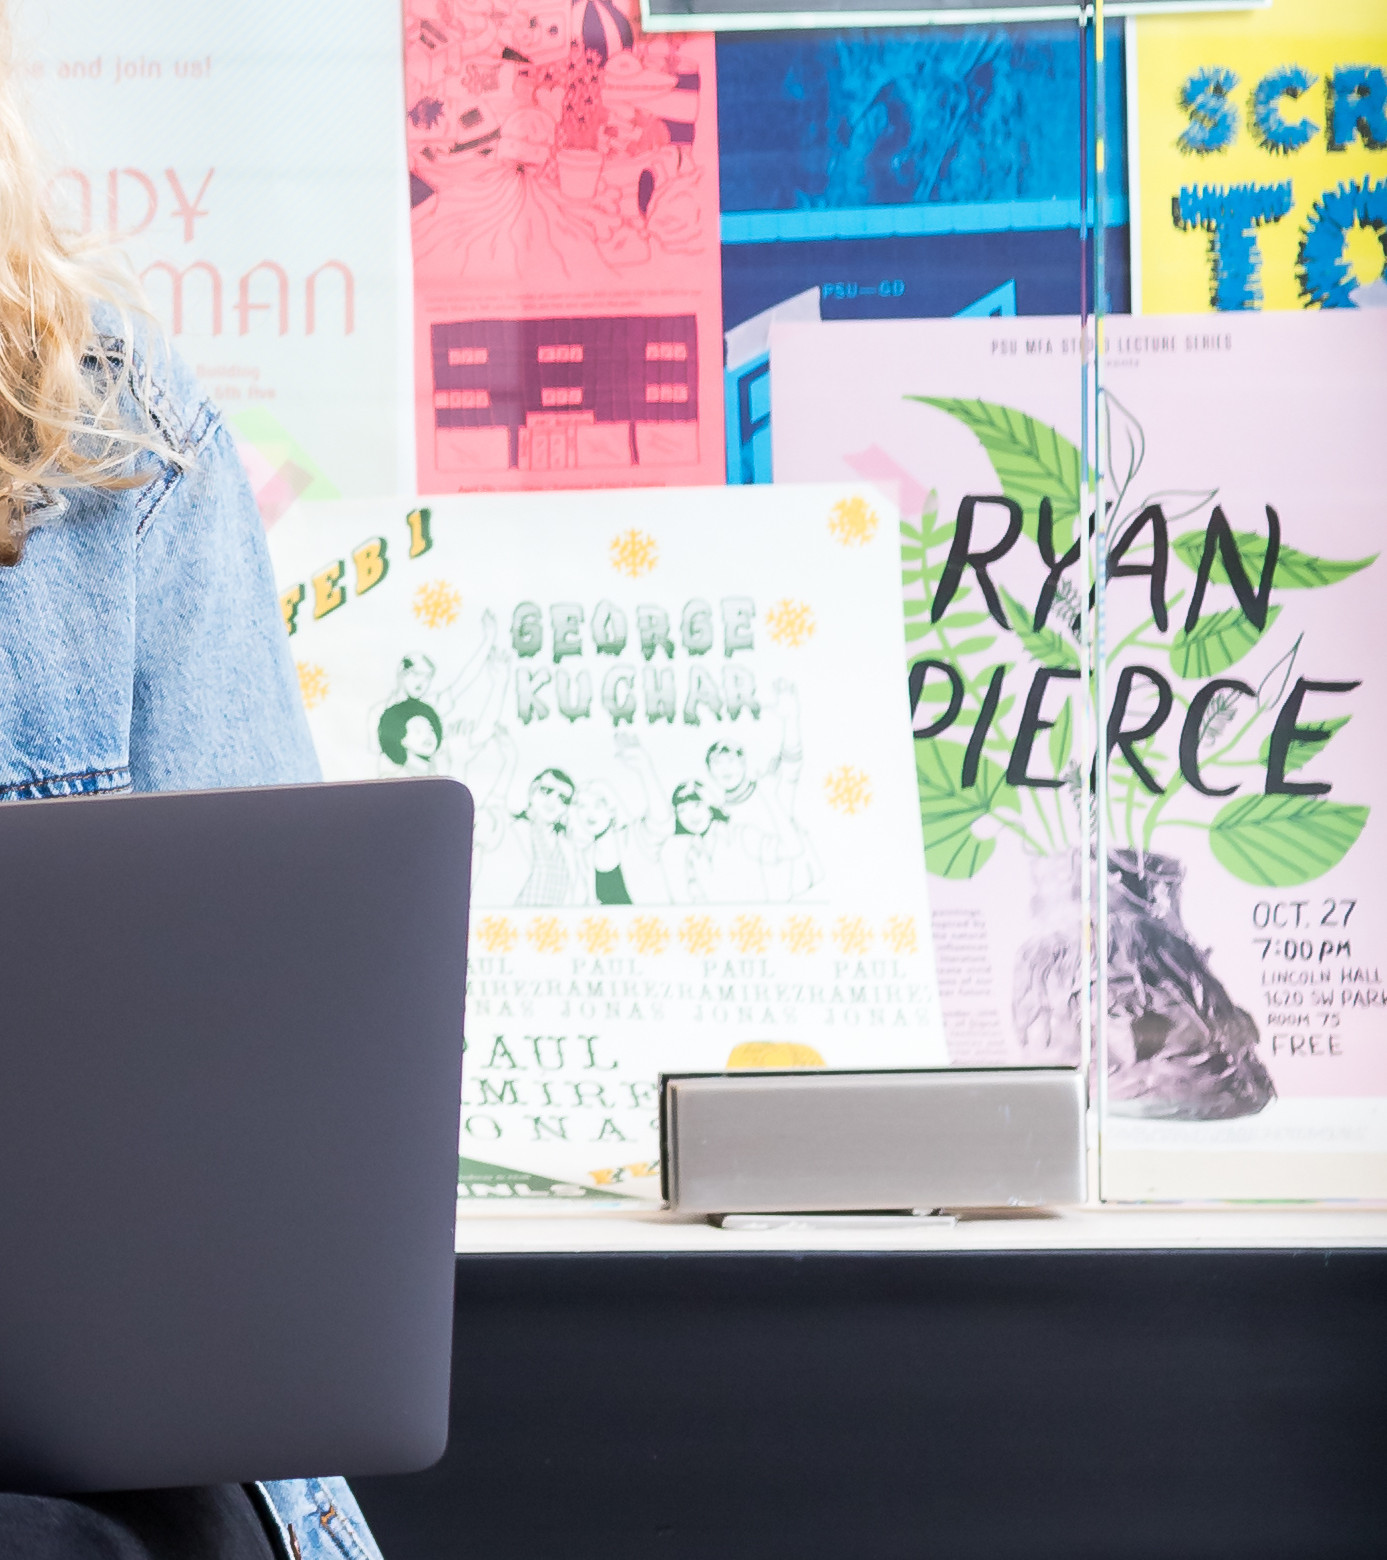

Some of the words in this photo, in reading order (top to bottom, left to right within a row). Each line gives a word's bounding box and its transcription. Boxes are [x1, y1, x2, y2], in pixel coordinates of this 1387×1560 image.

[929, 492, 1283, 634] RYAN
[510, 597, 756, 661] GEORGE
[517, 664, 761, 726] KUCHAR
[908, 662, 1362, 801] PIERCE
[1253, 900, 1311, 928] OCT.
[1320, 899, 1357, 927] 27
